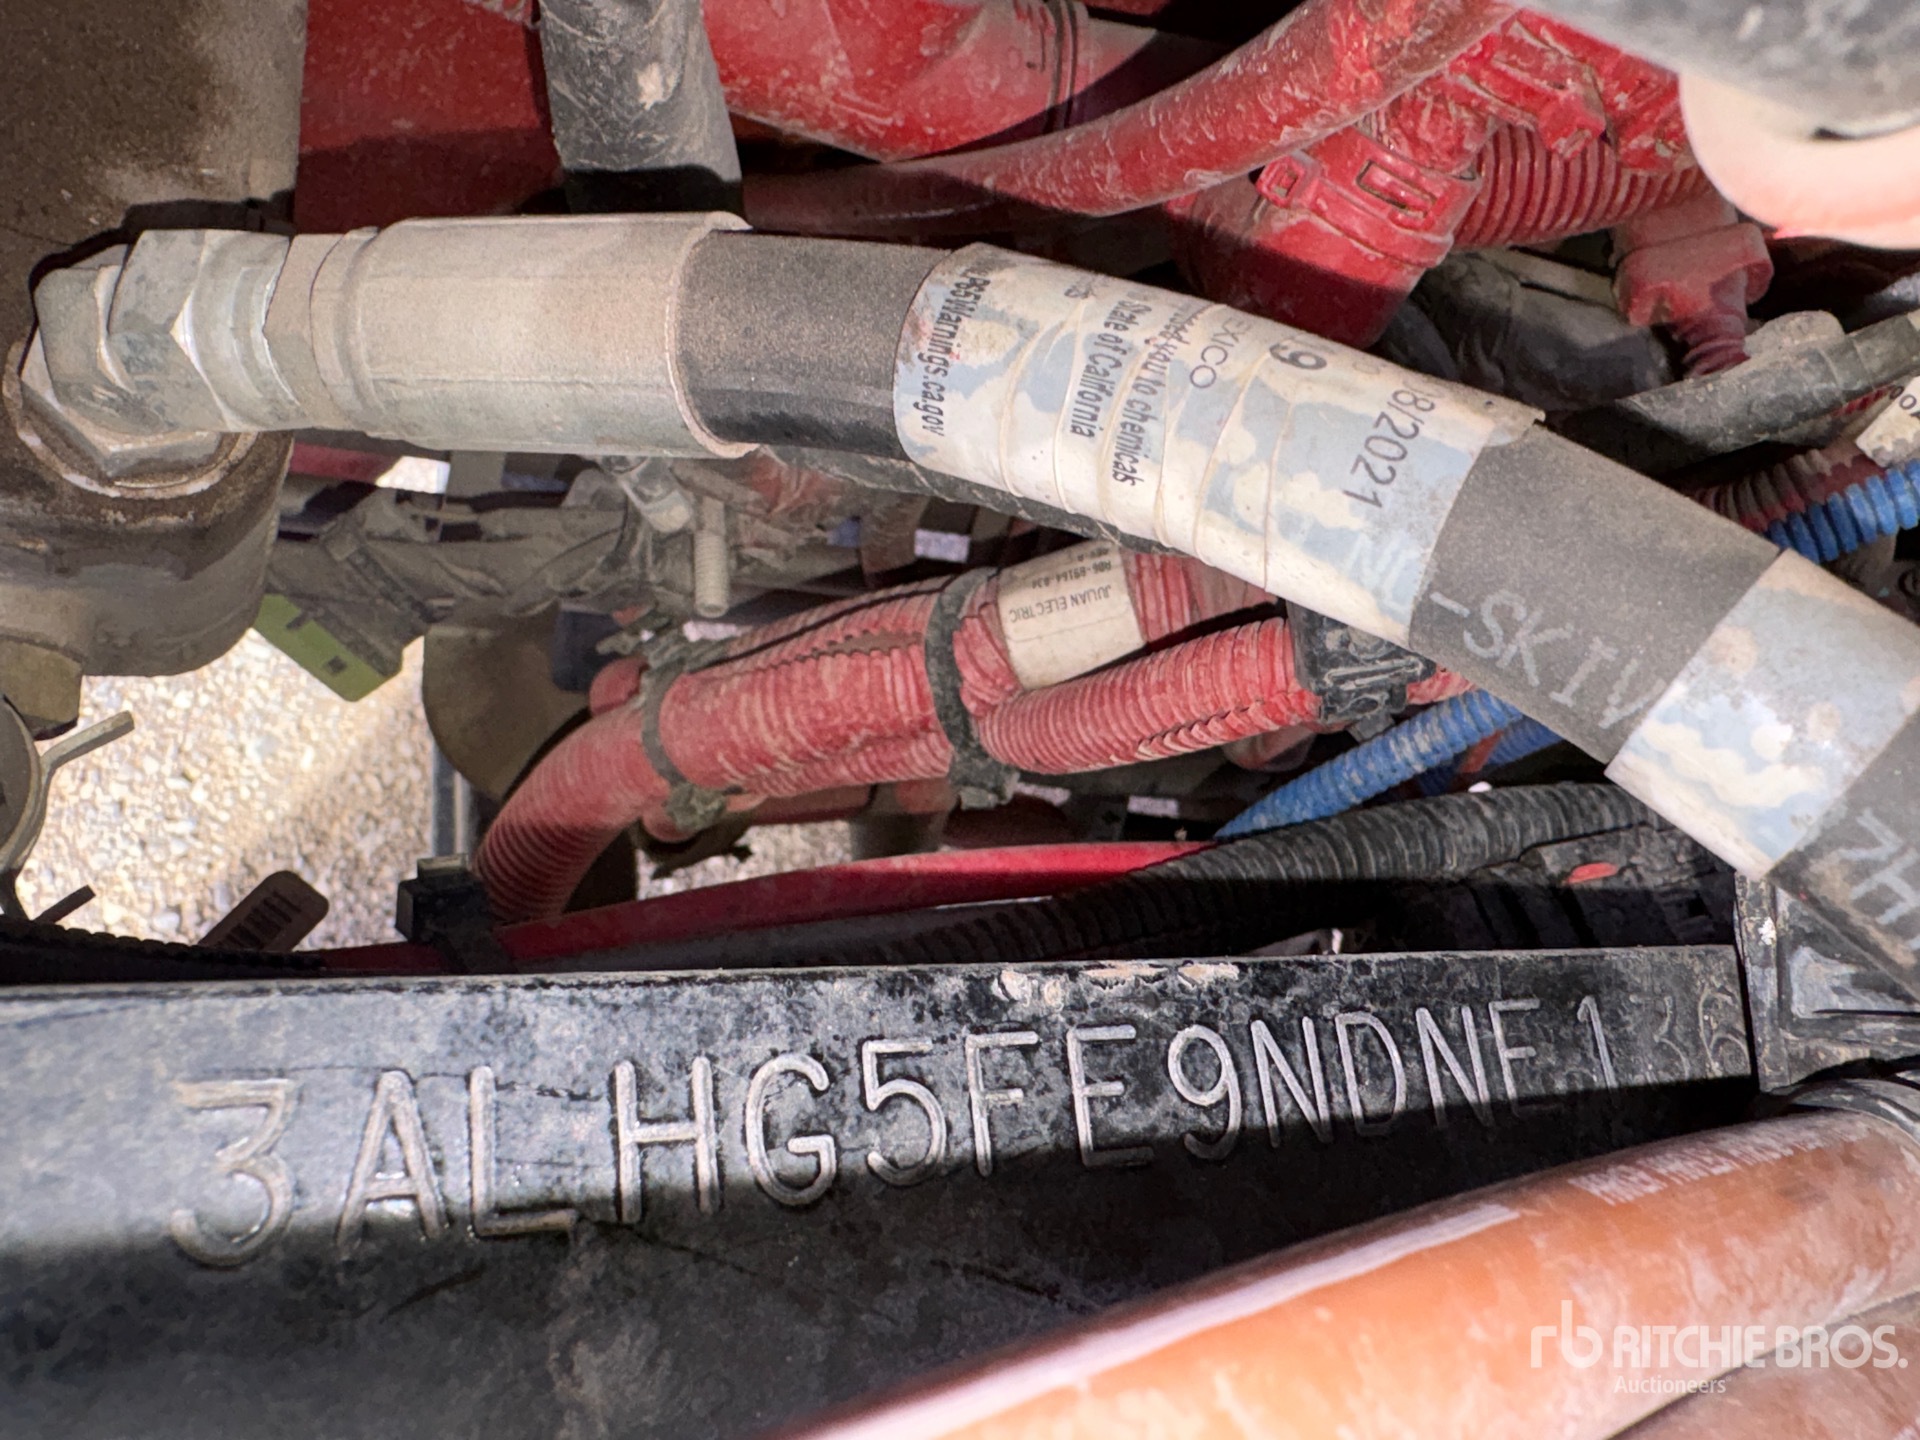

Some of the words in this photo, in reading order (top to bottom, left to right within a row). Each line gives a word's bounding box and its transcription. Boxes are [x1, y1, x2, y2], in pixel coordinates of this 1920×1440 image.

[1070, 352, 1124, 438] California
[1069, 584, 1112, 607] JULIAN
[1009, 596, 1068, 623] ELECTRIC
